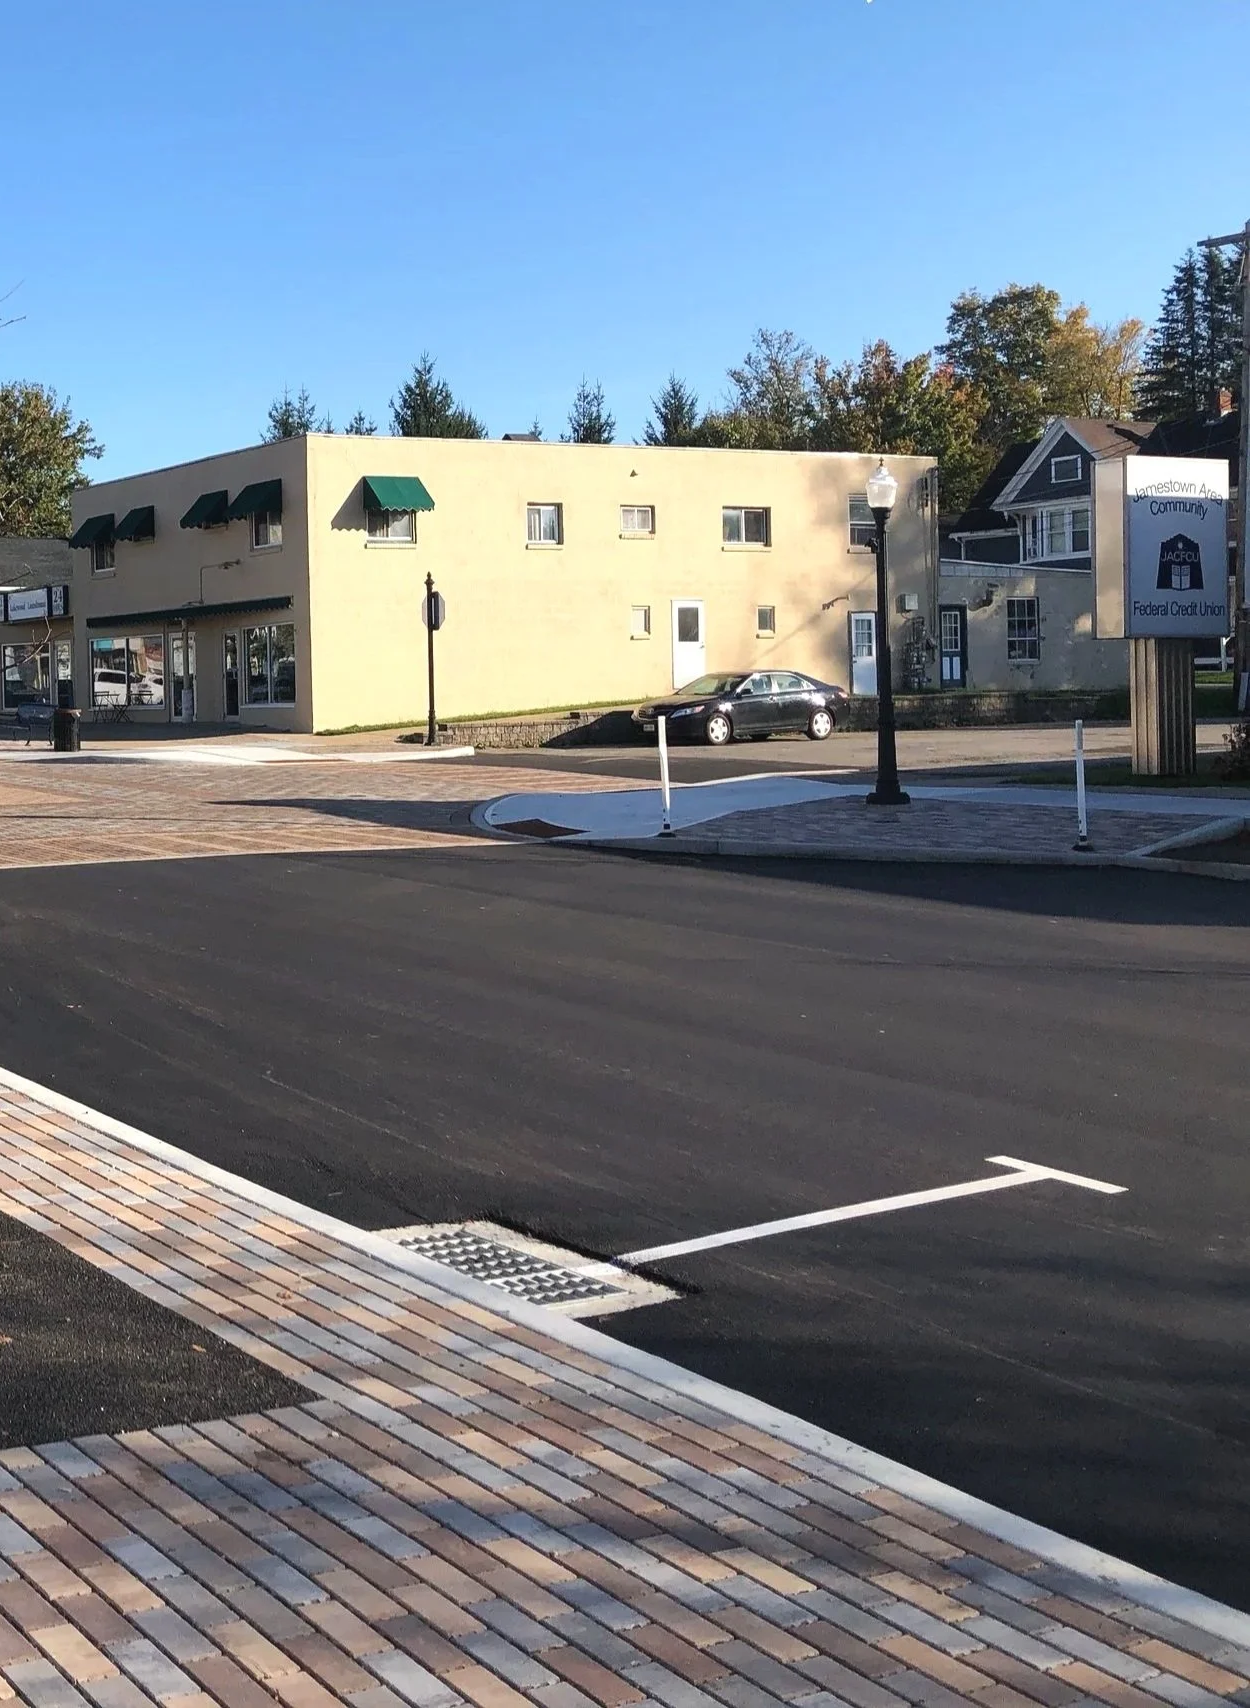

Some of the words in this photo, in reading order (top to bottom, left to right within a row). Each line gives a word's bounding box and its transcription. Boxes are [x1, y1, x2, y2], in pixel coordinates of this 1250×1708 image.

[1133, 479, 1196, 503] Jamestown
[1198, 483, 1223, 507] Area
[1150, 500, 1208, 520] Community
[1161, 551, 1199, 562] JACFCU
[1133, 601, 1169, 616] Federal
[1170, 601, 1198, 616] Credit
[1199, 601, 1225, 616] Union
